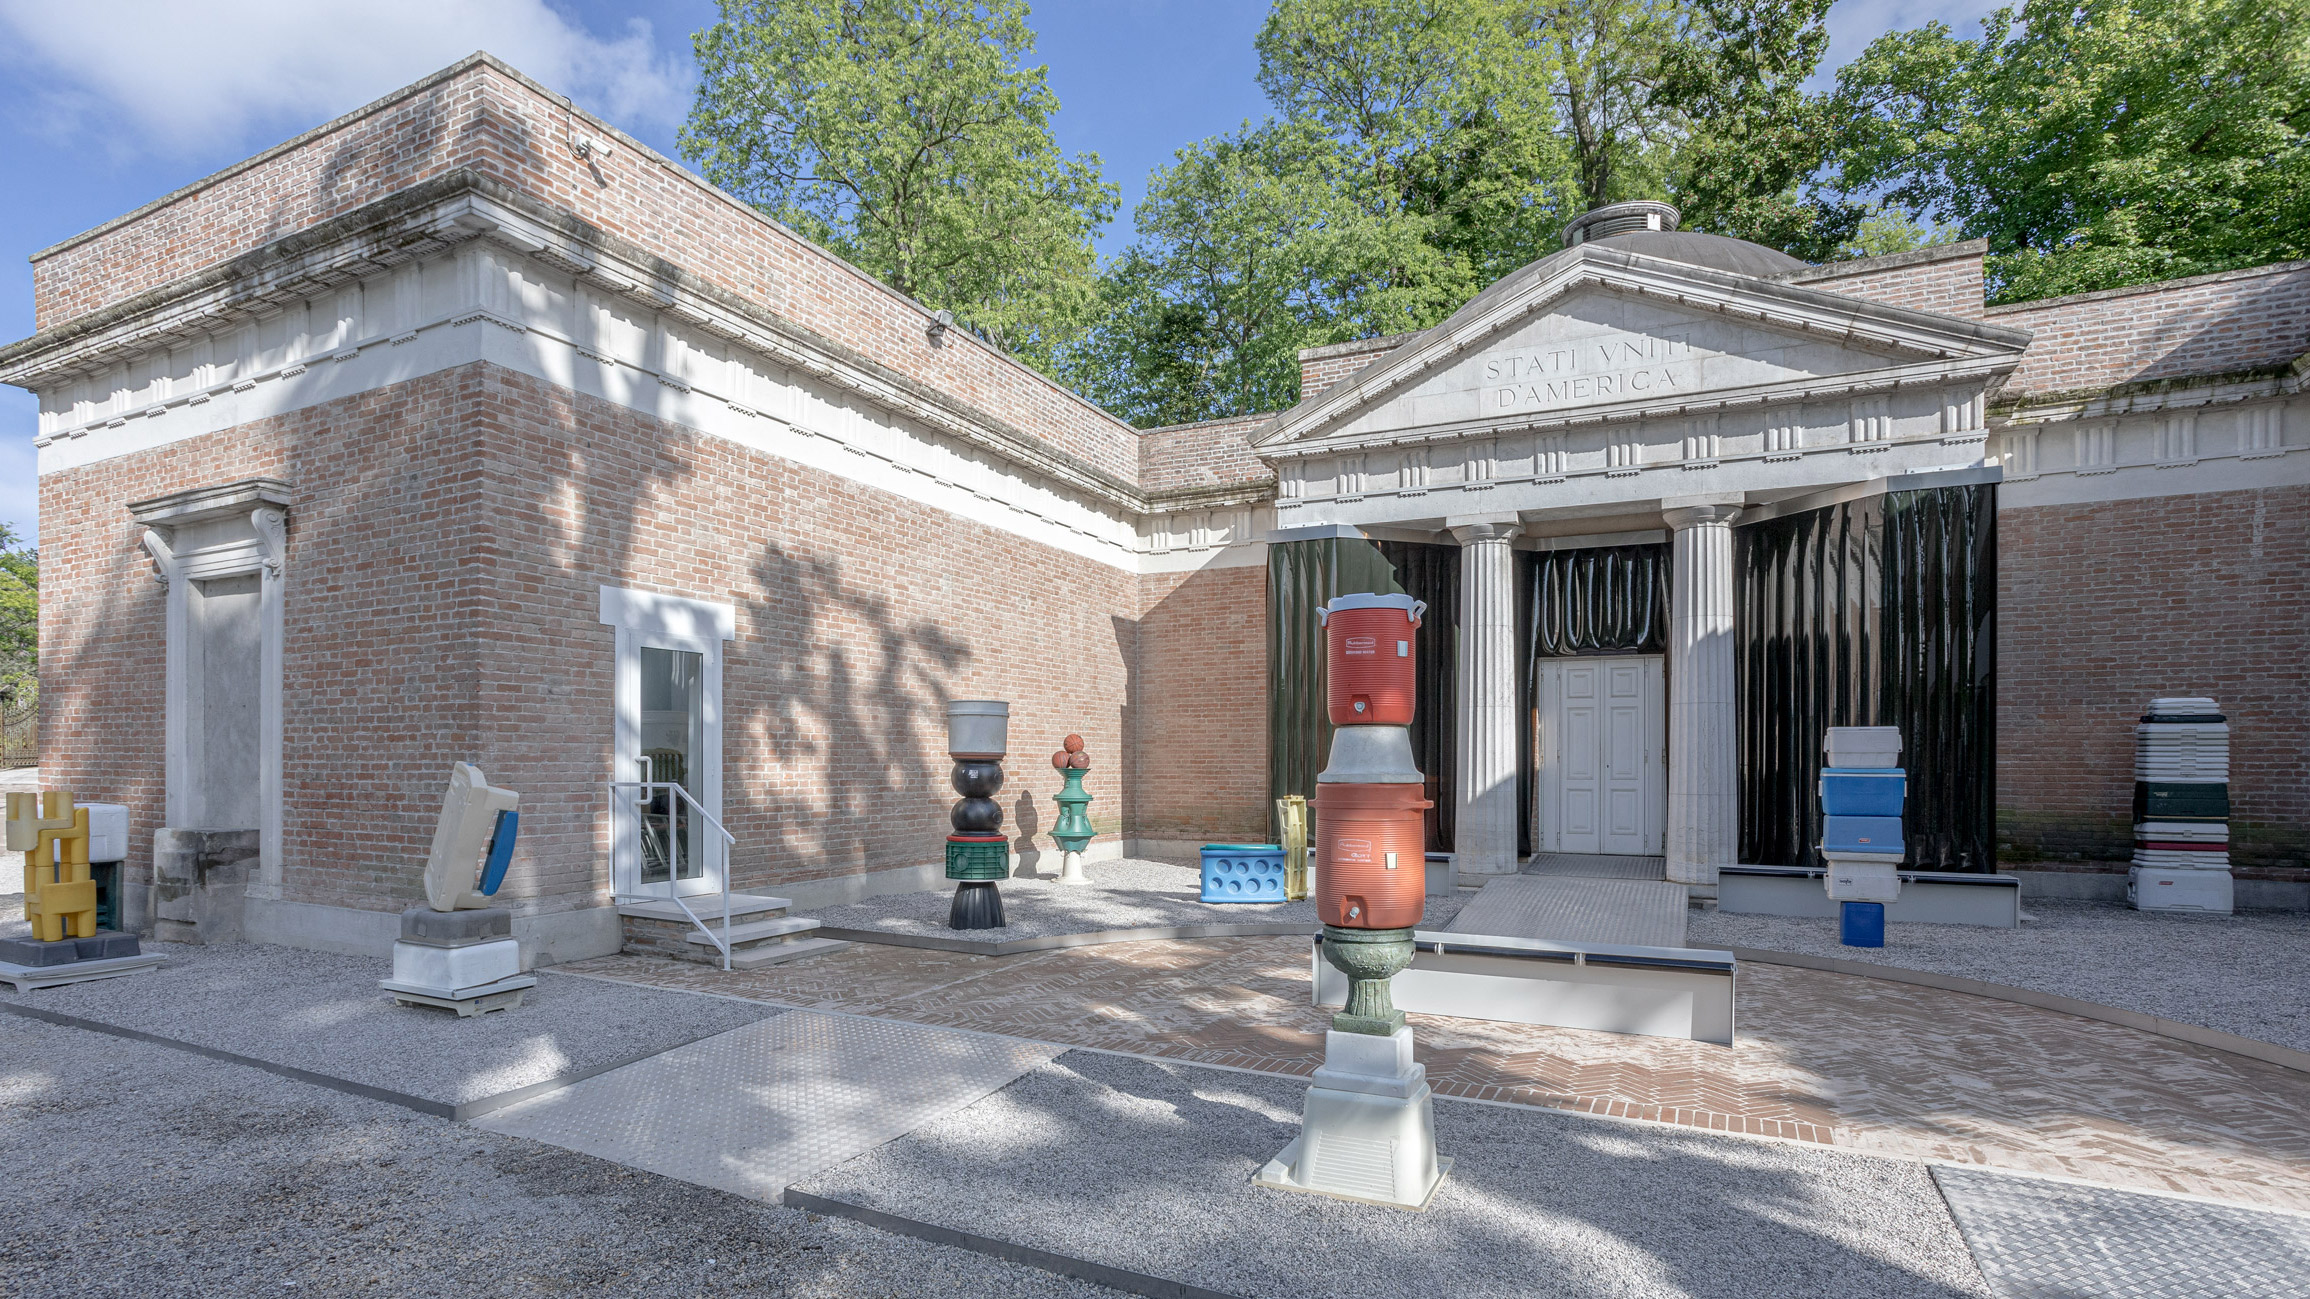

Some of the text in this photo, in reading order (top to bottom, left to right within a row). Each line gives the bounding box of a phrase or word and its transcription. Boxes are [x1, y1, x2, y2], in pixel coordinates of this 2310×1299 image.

[1486, 332, 1691, 380] STATI VNITI
[1498, 368, 1676, 408] D'AMERICA
